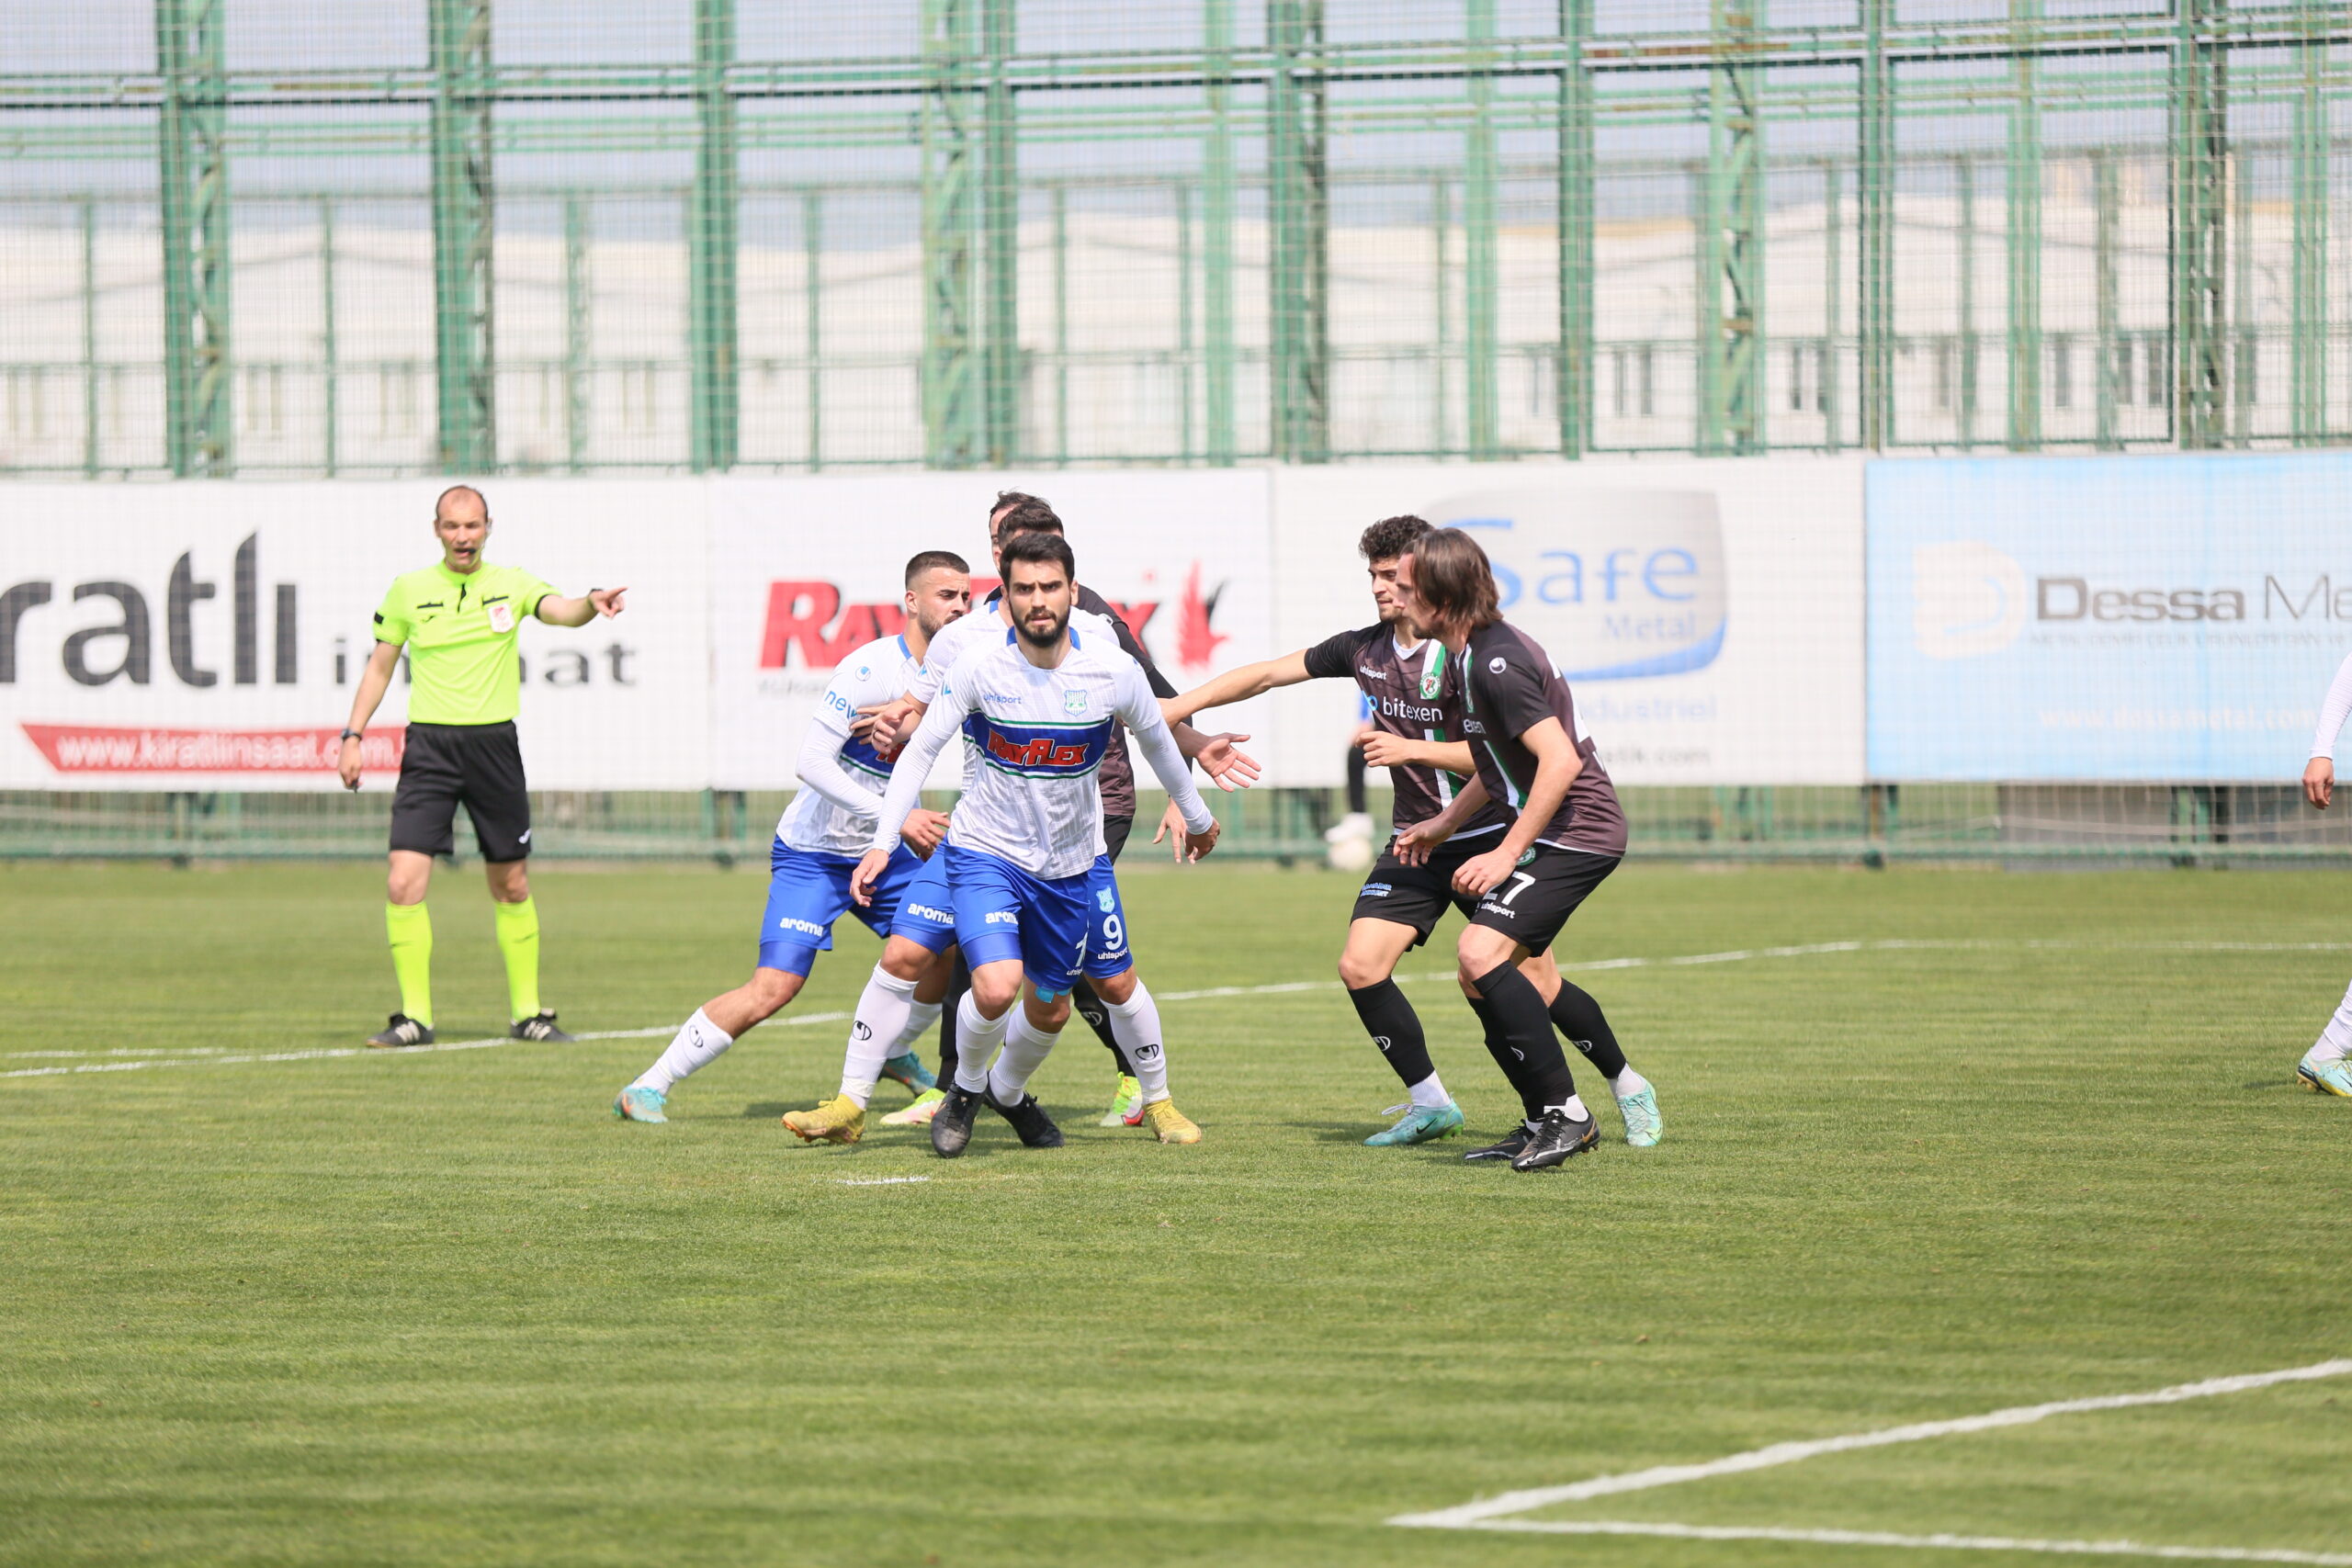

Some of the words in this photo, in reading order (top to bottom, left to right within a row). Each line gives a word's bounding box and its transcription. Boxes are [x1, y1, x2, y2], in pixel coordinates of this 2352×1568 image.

[2037, 574, 2245, 622] Dessa
[1603, 614, 1696, 639] Metal
[1360, 665, 1387, 681] uhlsport
[983, 694, 1022, 705] uhlsport
[1383, 696, 1443, 722] bitexen
[908, 903, 956, 925] aroma
[1102, 914, 1123, 951] 9
[1098, 946, 1128, 961] uhlsport
